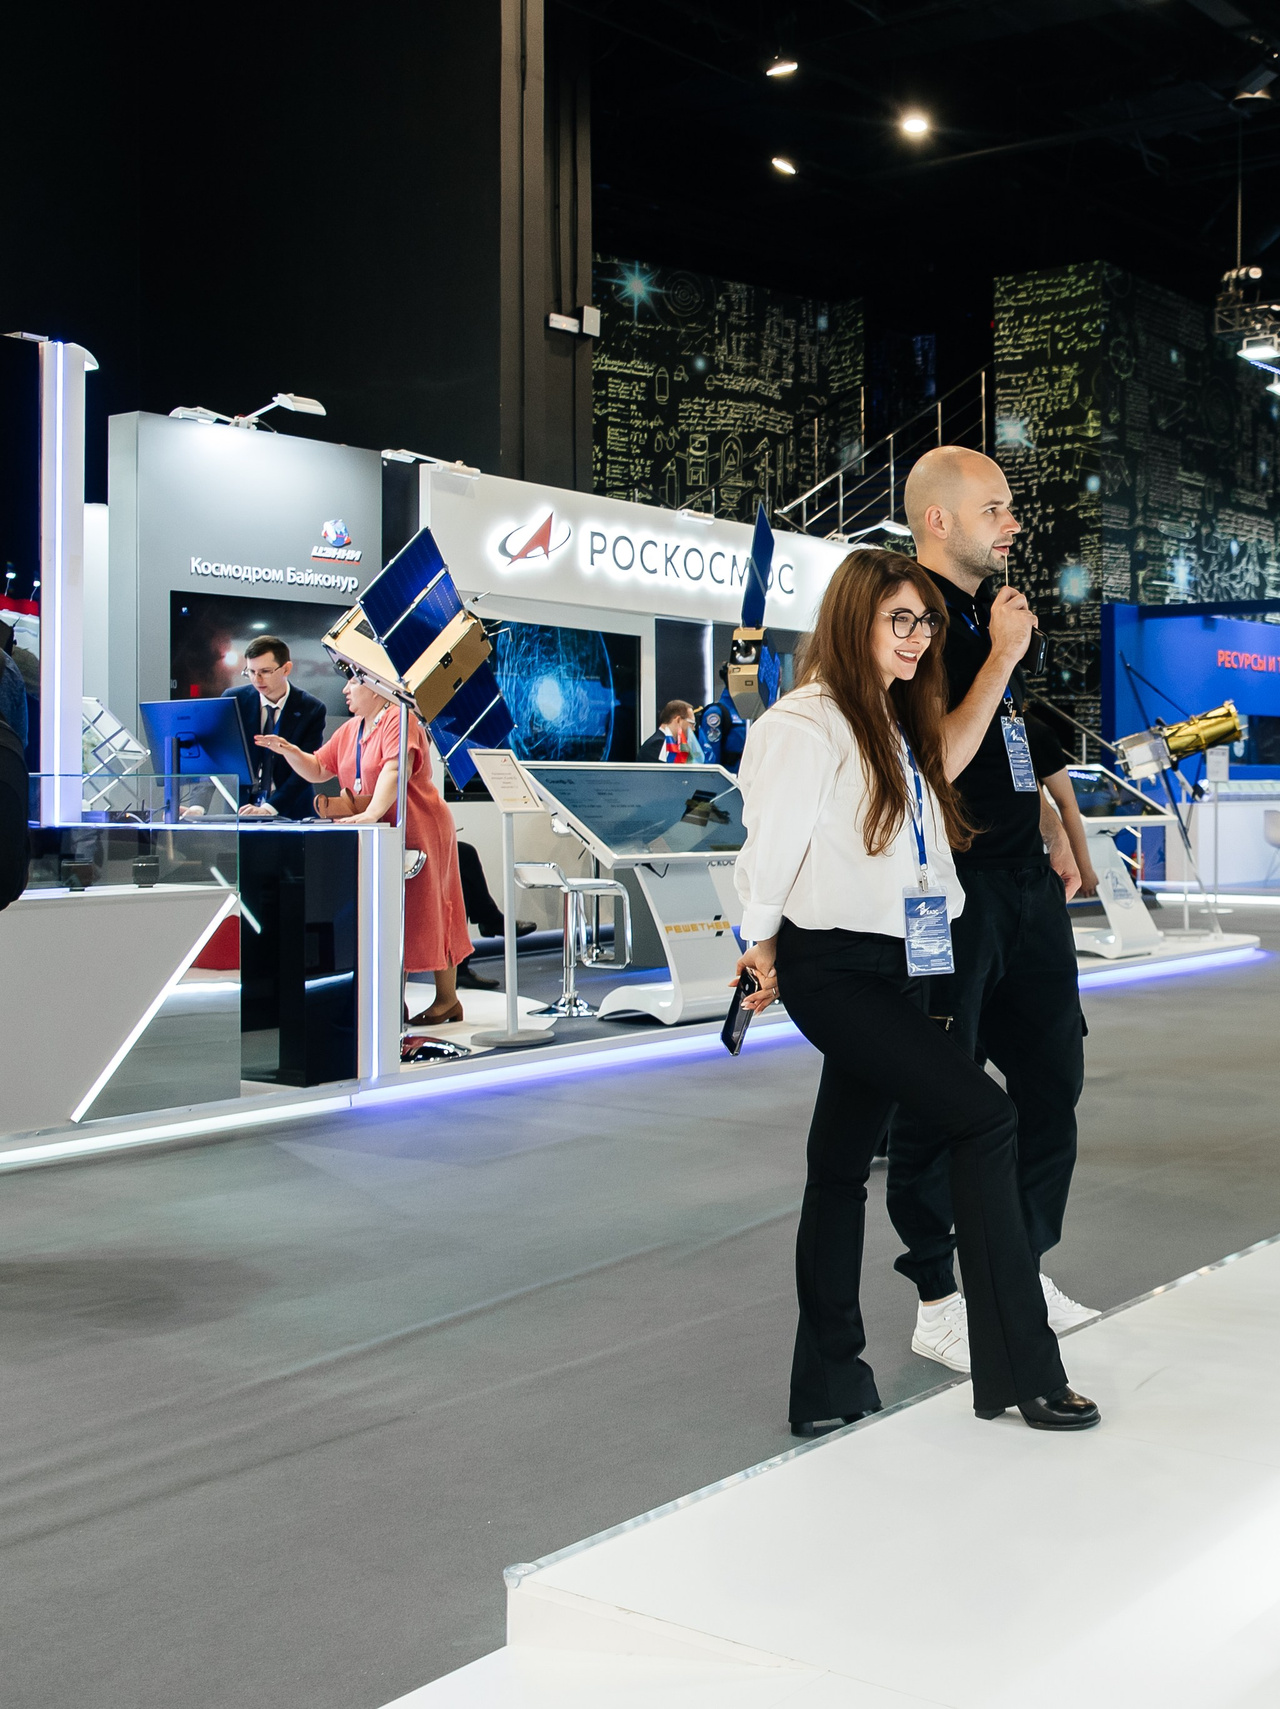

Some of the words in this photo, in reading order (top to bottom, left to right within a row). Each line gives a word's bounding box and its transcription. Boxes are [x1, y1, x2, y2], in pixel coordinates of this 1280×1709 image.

[190, 556, 284, 584] Космодром
[286, 566, 359, 593] Байконур
[590, 530, 795, 595] РОСКОСМС
[1217, 649, 1267, 672] РЕСУРСЫ
[1268, 655, 1276, 673] И
